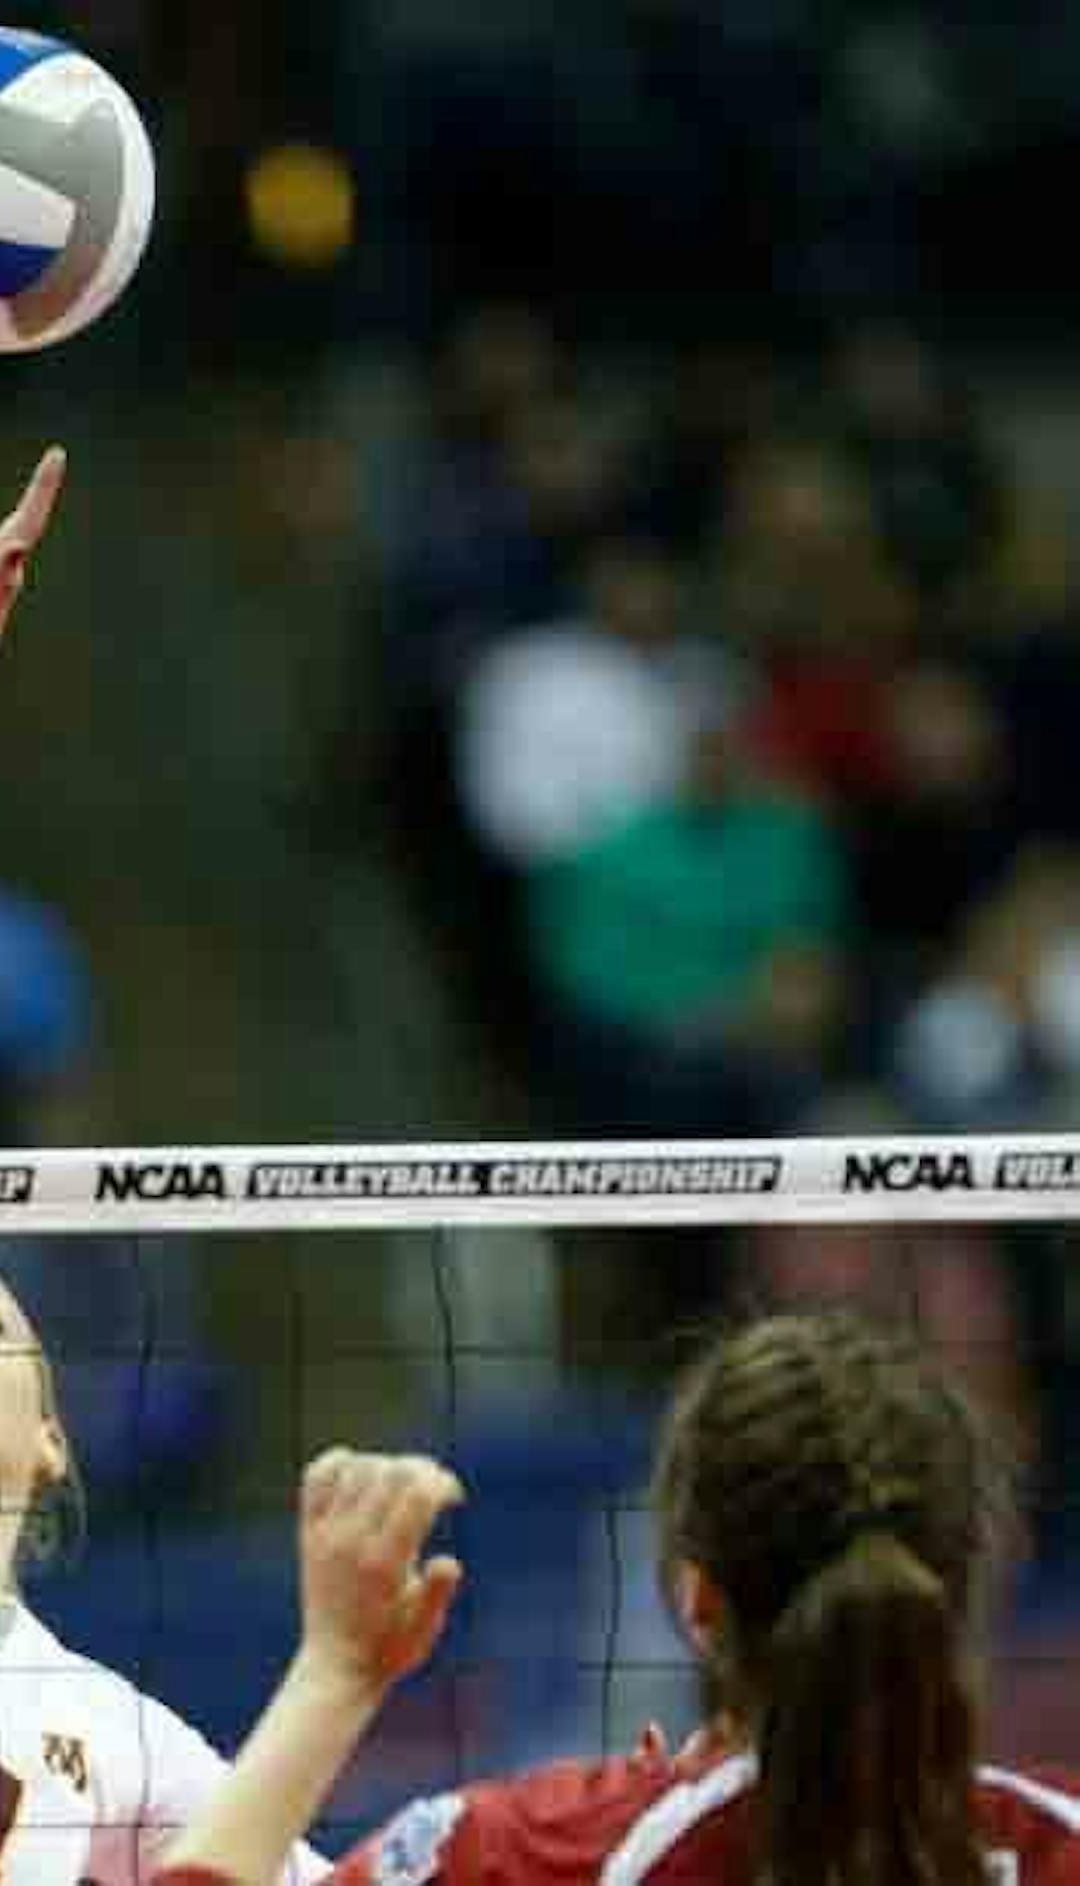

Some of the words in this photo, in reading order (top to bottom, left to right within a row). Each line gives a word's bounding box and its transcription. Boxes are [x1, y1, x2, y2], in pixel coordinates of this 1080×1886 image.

[95, 1163, 226, 1201] NCAA
[253, 1164, 481, 1196] VOLLEYBALL
[489, 1160, 776, 1194] CHAMPIONSHIP
[843, 1154, 974, 1192] NCAA
